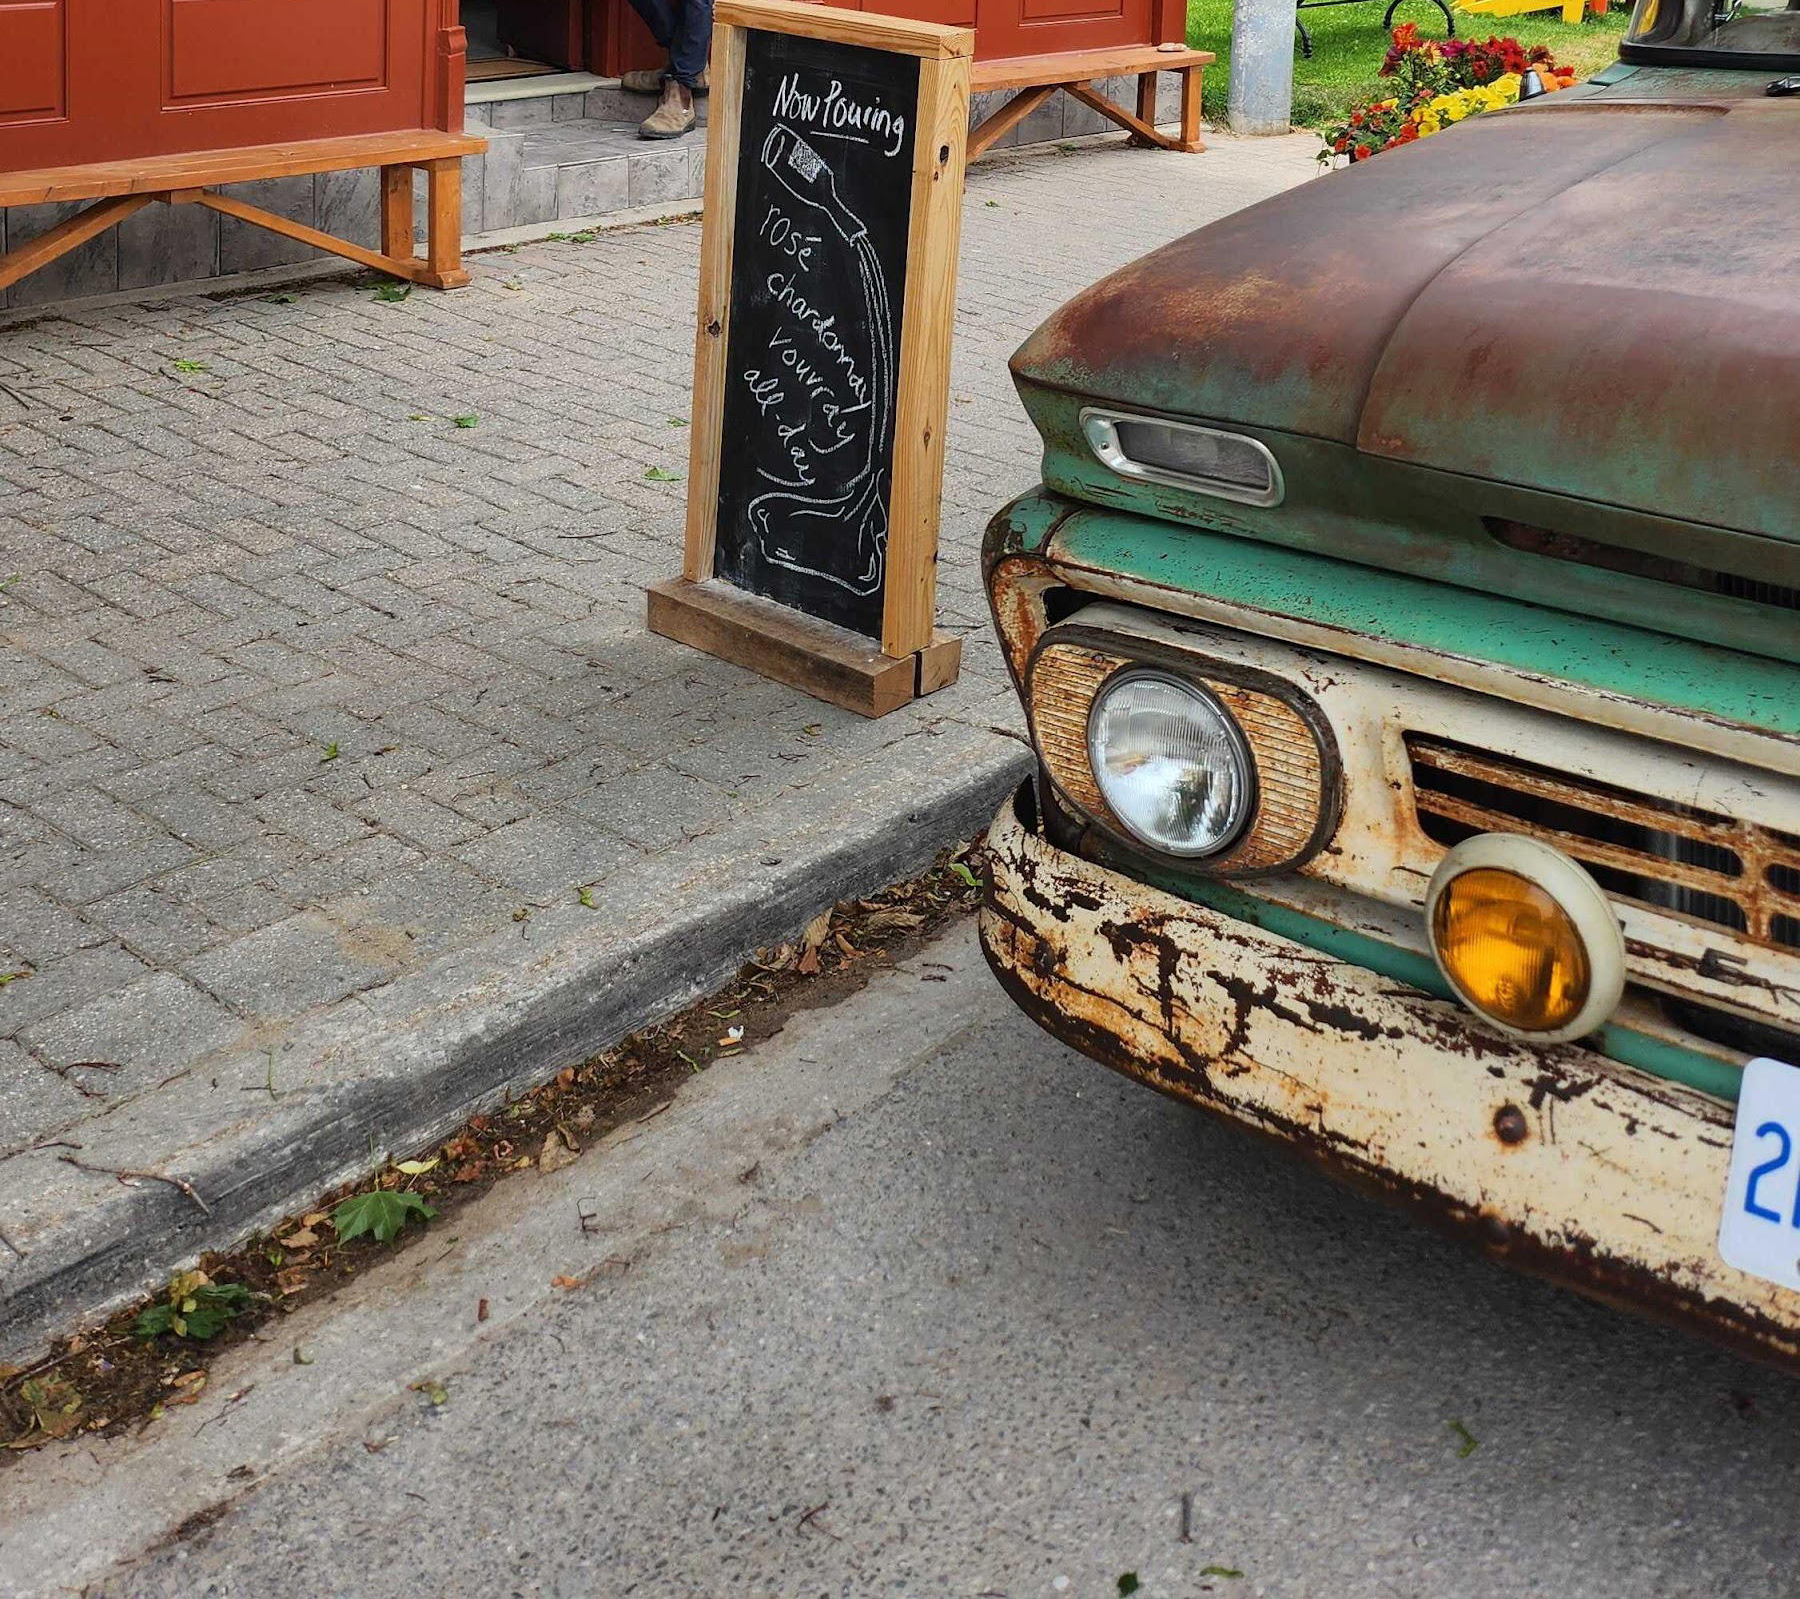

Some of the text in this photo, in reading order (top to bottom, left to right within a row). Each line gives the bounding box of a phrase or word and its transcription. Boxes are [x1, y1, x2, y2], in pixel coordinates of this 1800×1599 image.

[772, 72, 905, 158] Now Pouring
[766, 271, 873, 415] chardonnay
[768, 325, 856, 454] vouvray
